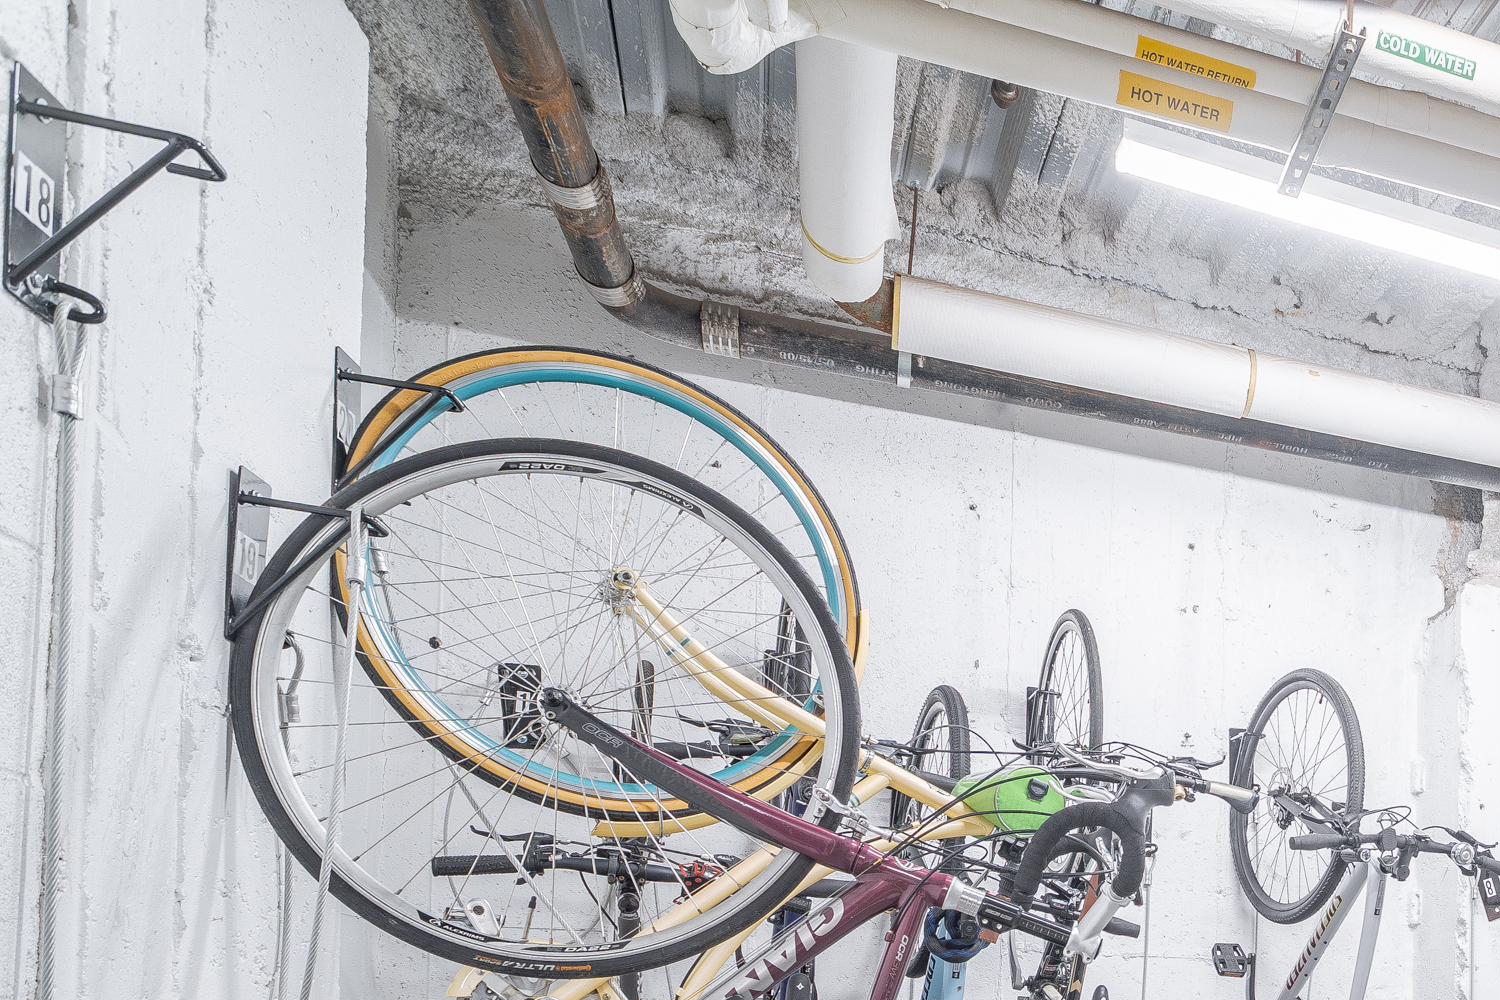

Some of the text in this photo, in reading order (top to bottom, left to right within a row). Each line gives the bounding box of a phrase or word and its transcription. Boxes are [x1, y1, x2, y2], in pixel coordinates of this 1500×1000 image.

[1141, 49, 1250, 87] HOT WATER RETURN
[1380, 33, 1475, 77] COLD WATER
[1130, 86, 1220, 122] HOT WATER
[24, 165, 51, 228] 18
[642, 483, 682, 504] ALEXRIMS
[239, 537, 257, 581] 19
[582, 722, 624, 749] OCR
[443, 923, 486, 942] ALEXRIMS
[501, 959, 556, 972] ULTRA
